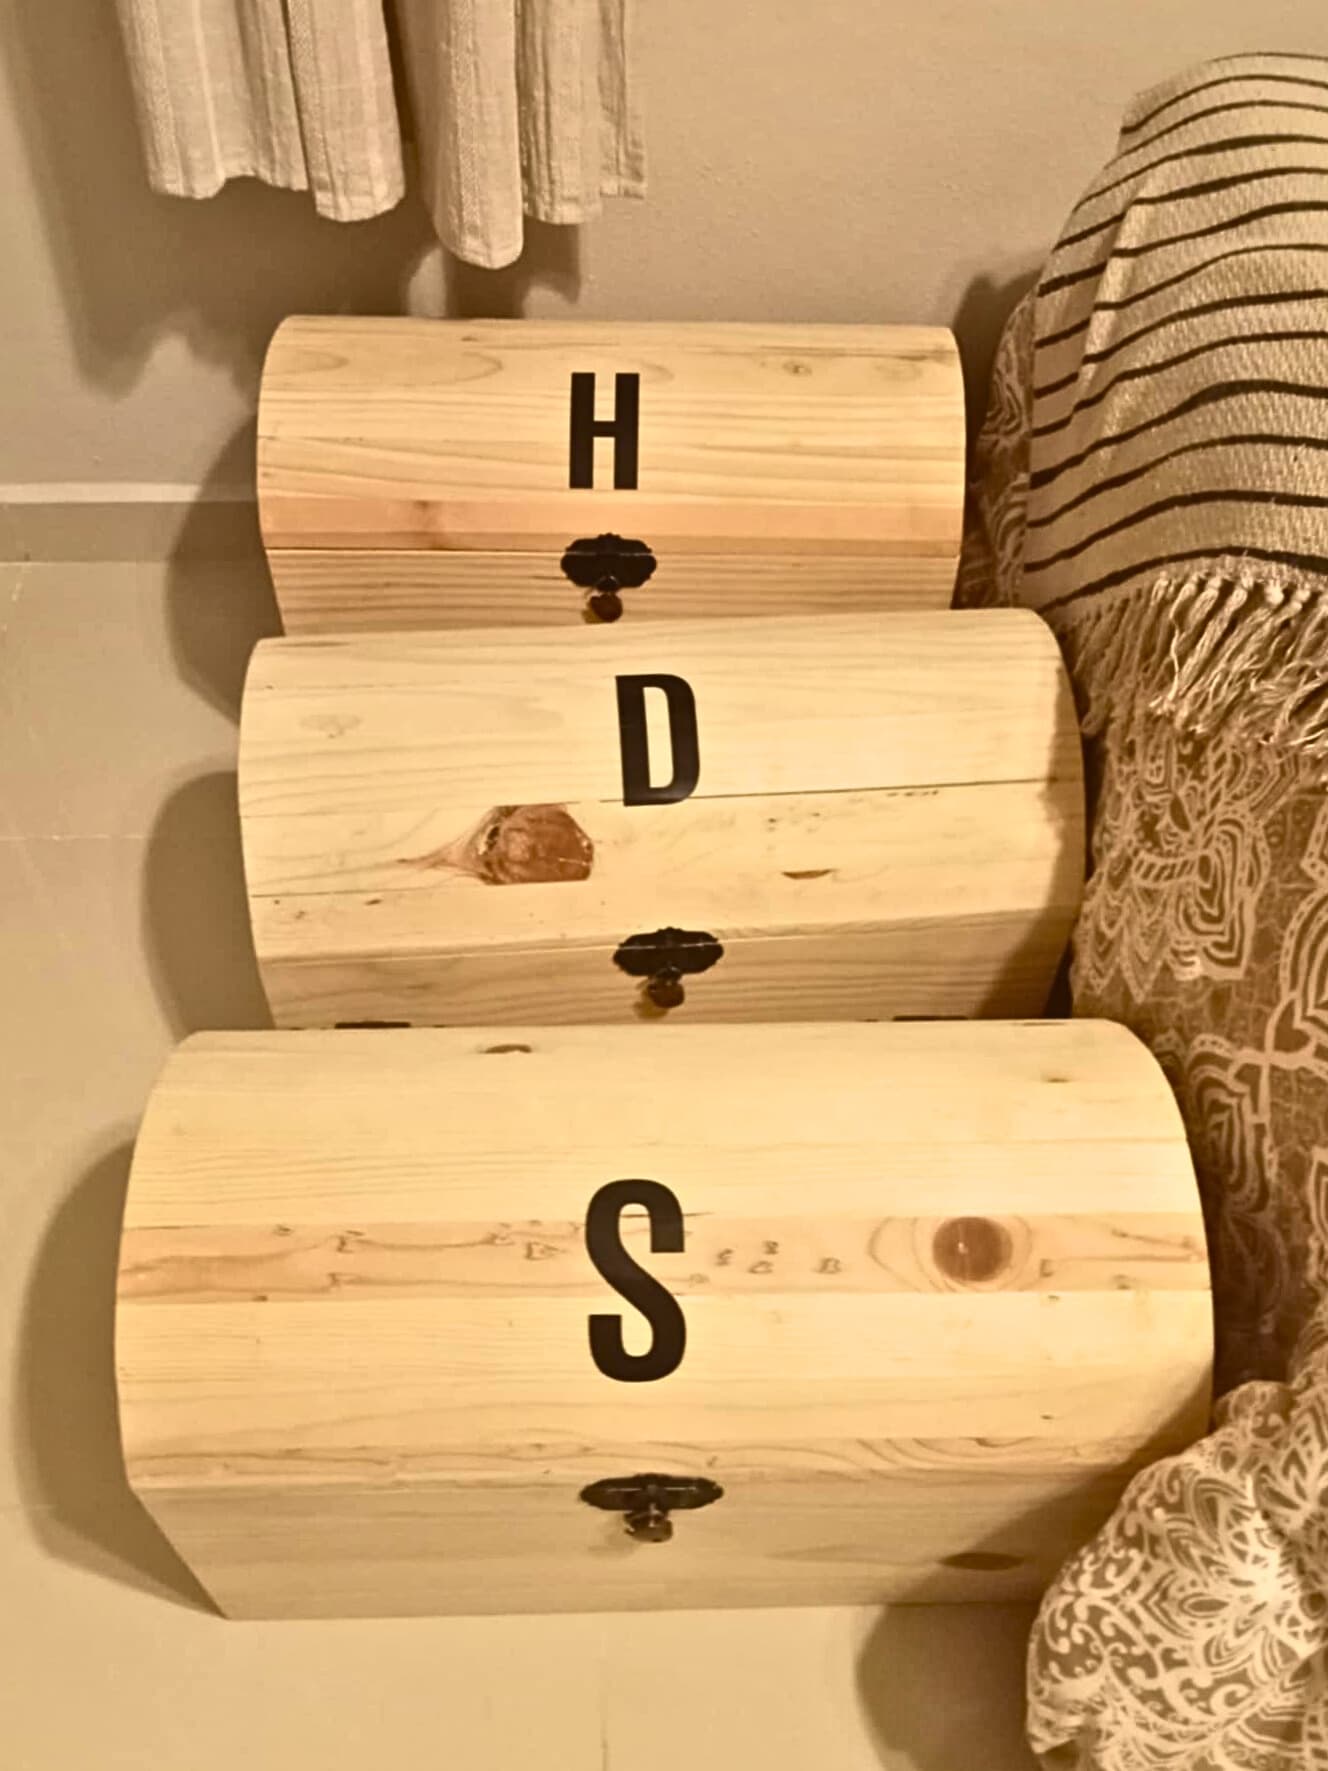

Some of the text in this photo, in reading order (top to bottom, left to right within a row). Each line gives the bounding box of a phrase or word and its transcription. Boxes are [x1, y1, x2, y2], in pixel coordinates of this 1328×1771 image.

[569, 372, 640, 490] H
[616, 673, 700, 807] D
[585, 1179, 686, 1383] S
